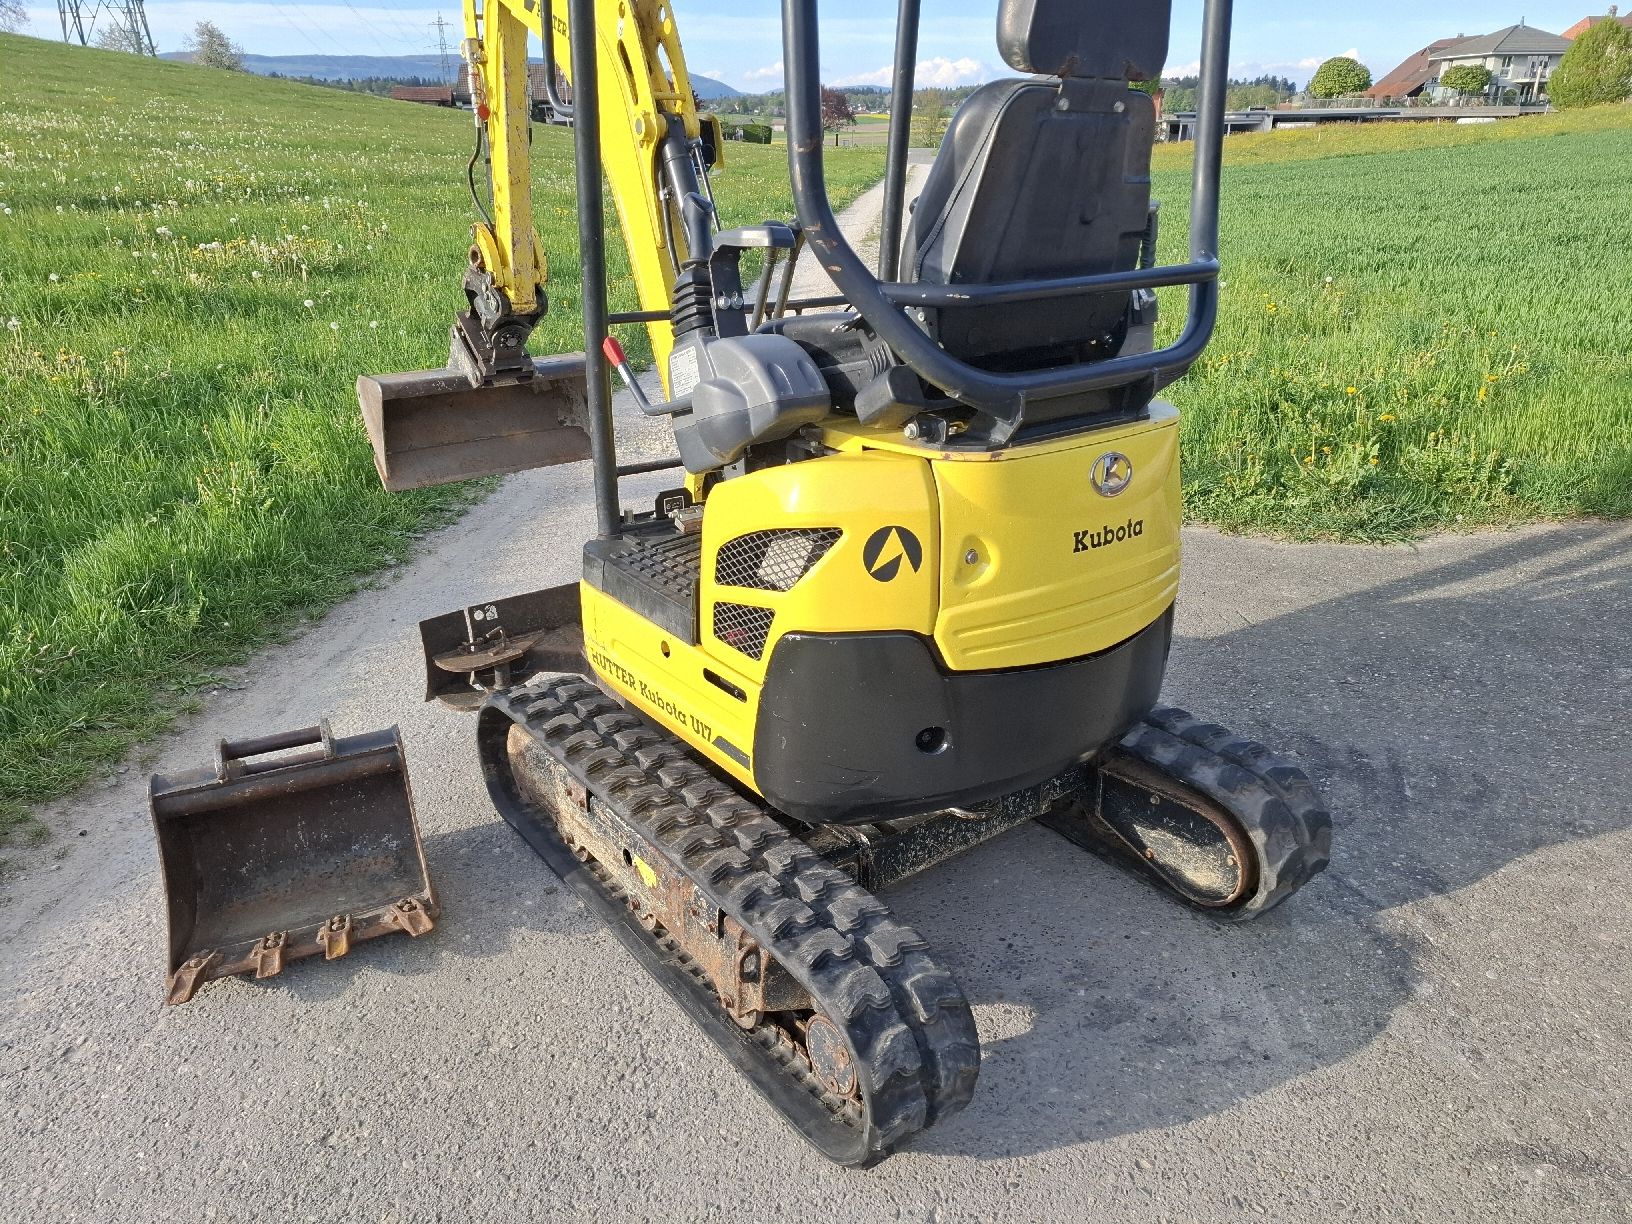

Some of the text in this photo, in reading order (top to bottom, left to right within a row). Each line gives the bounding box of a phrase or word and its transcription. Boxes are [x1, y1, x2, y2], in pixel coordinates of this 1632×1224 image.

[1073, 518, 1143, 553] Kubota
[590, 647, 712, 742] HUTTER Kubota U17
